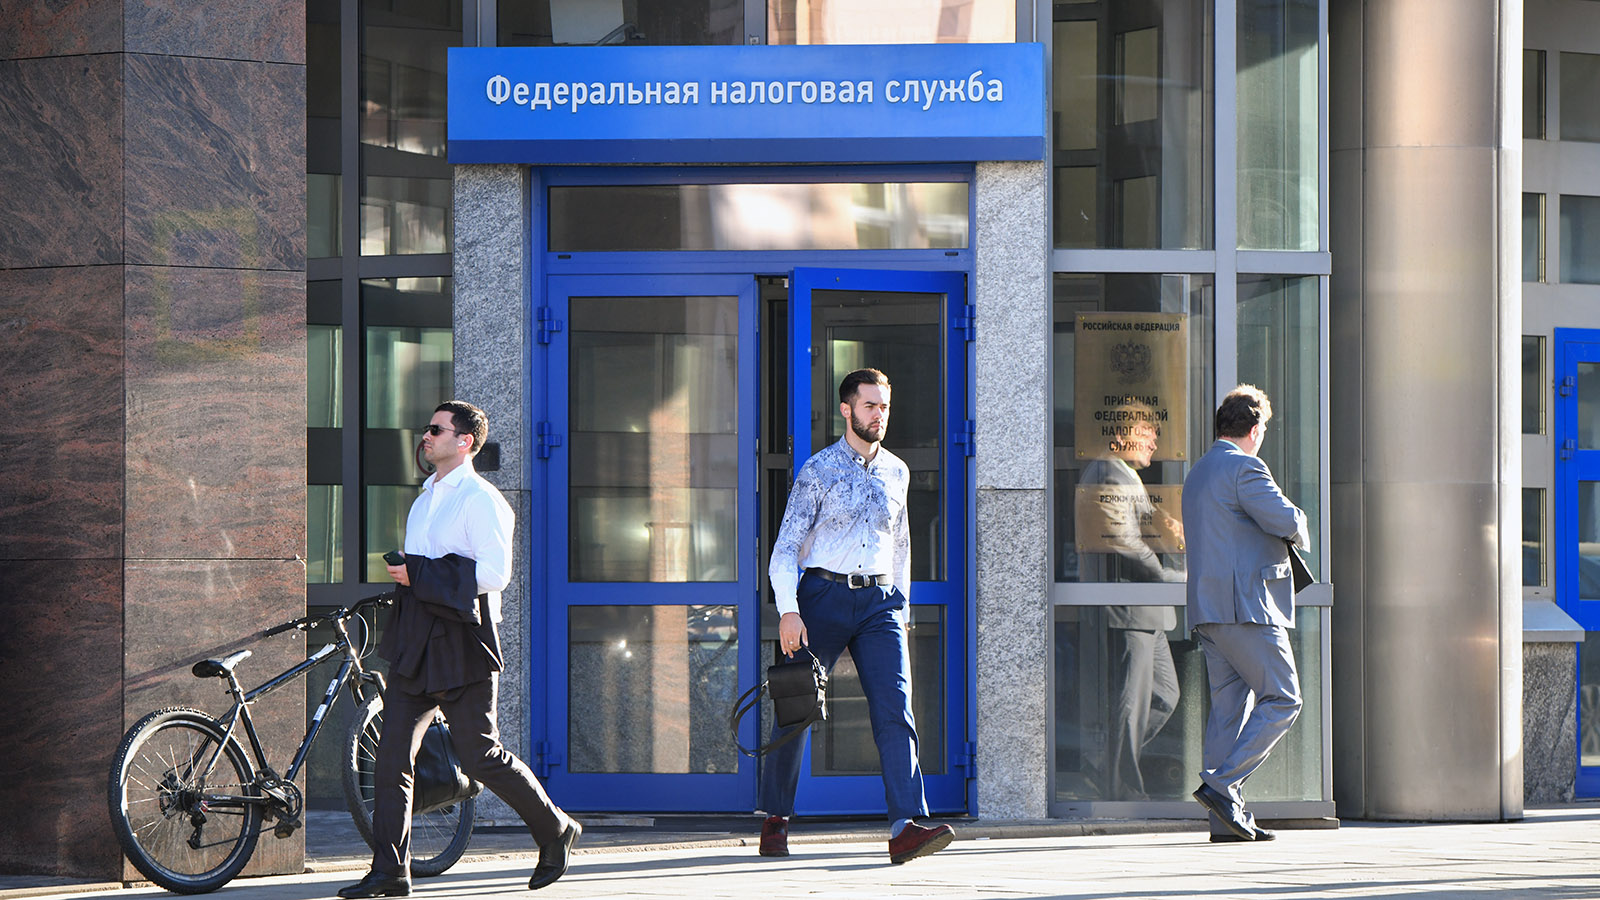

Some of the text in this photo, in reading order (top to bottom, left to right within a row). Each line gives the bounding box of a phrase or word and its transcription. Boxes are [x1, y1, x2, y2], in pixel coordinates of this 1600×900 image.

[486, 70, 1004, 113] Федеральная налоговая служба
[1083, 321, 1180, 332] РОССИЙСКАЯ ФЕДЕРАЦИЯ
[1104, 394, 1158, 406] ПРИЁМНАЯ
[1094, 409, 1168, 422] ФЕДЕРАЛЬНОЙ
[1130, 495, 1163, 504] РАБТЫ:
